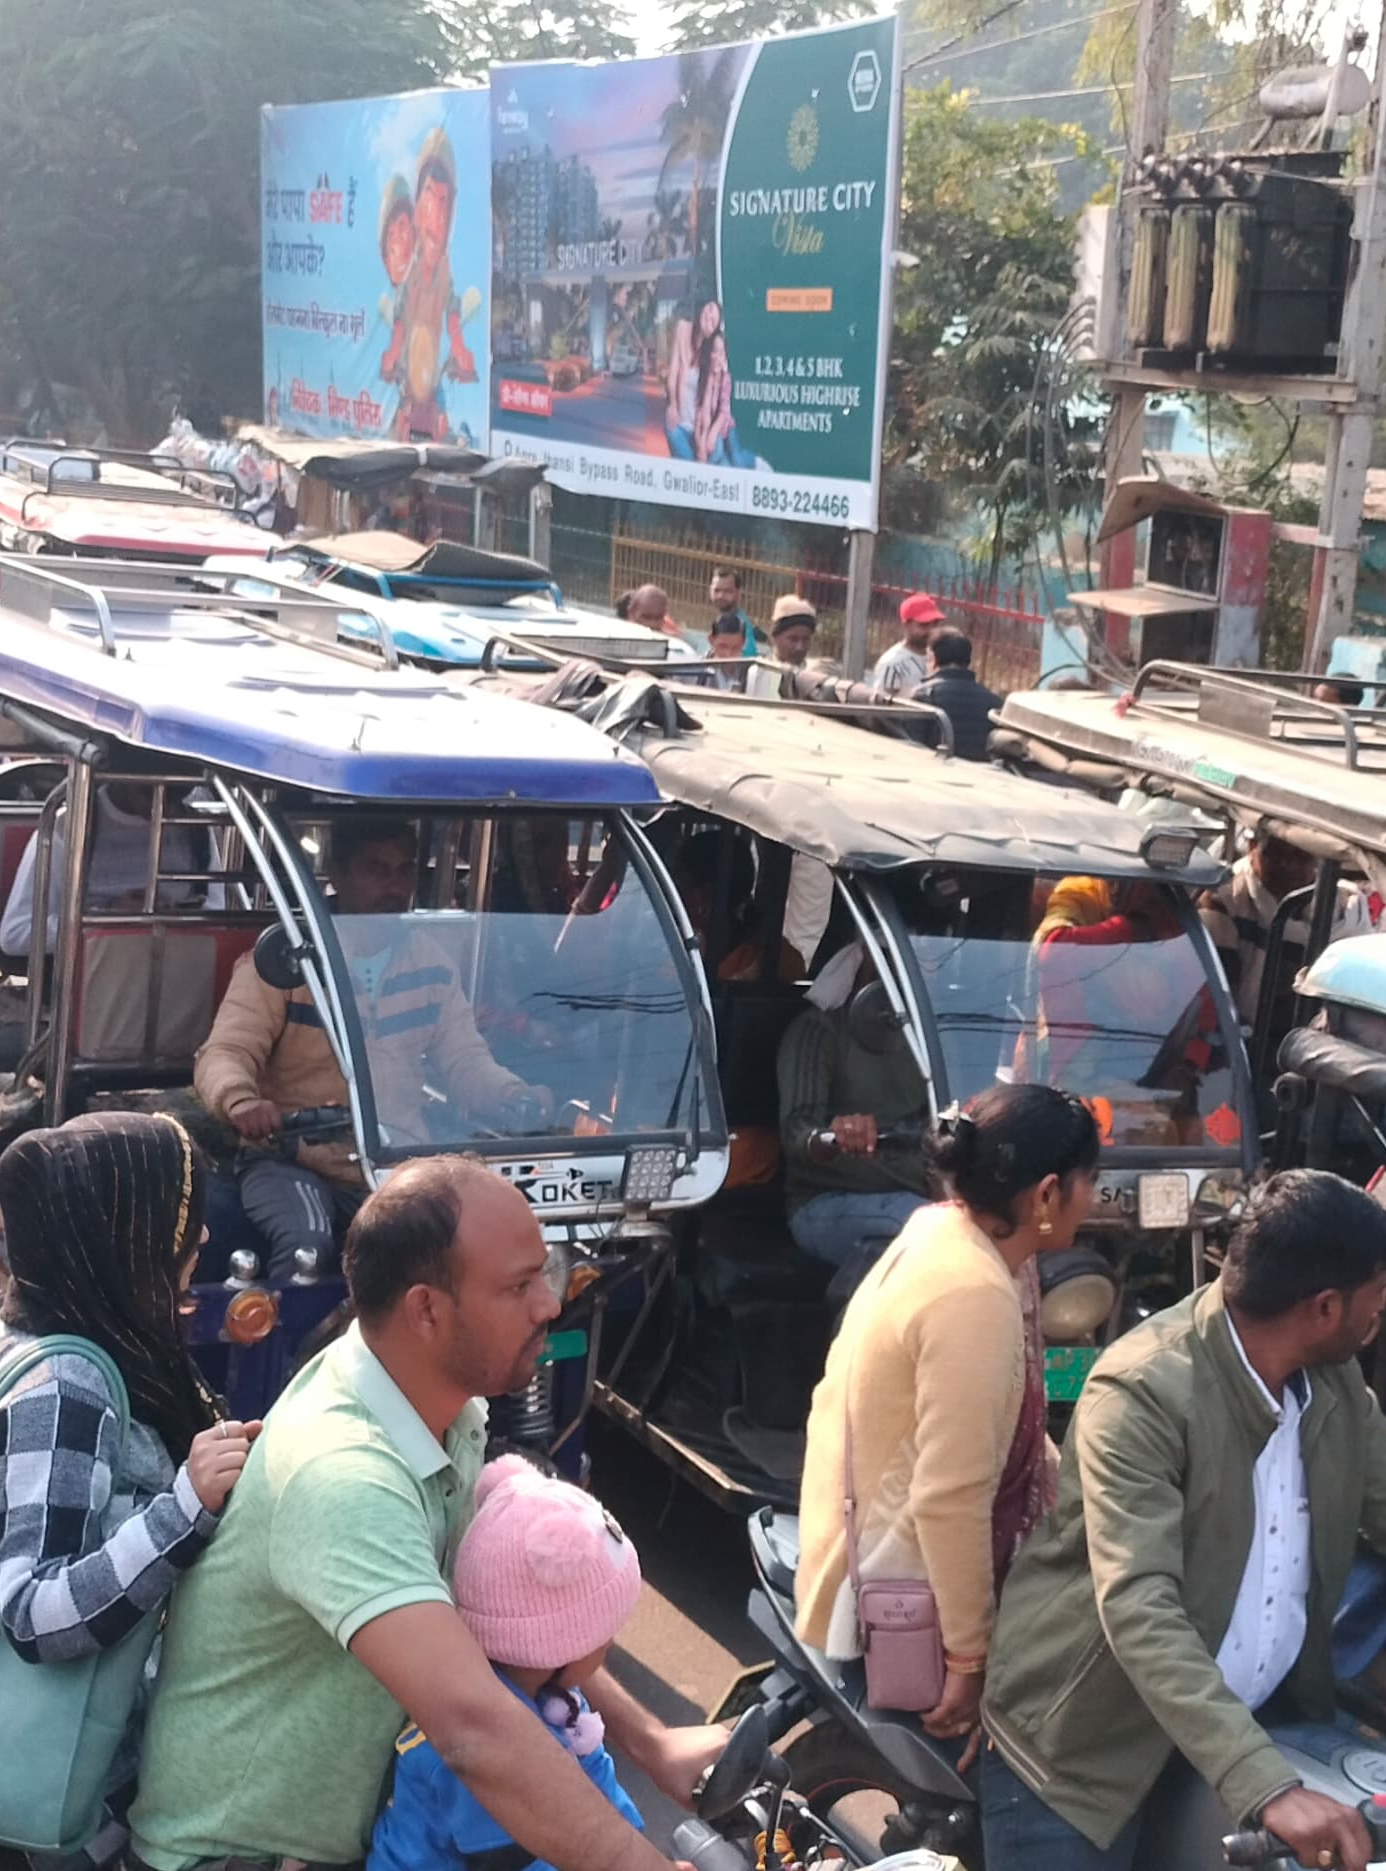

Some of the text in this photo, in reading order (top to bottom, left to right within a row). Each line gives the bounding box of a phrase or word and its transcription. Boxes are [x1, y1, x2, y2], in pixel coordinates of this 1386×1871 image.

[730, 181, 875, 216] SIGNATURE CITY
[772, 211, 824, 256] Vista
[557, 238, 617, 271] SIGNATURE
[807, 357, 815, 377] 5
[816, 357, 843, 378] BHK
[734, 381, 861, 407] LUXURIOUS HIGHRISE
[757, 410, 832, 433] APARTMENTS
[579, 457, 618, 482] Bypass
[664, 470, 739, 502] Gwalior-East
[752, 485, 849, 518] 8893-224466
